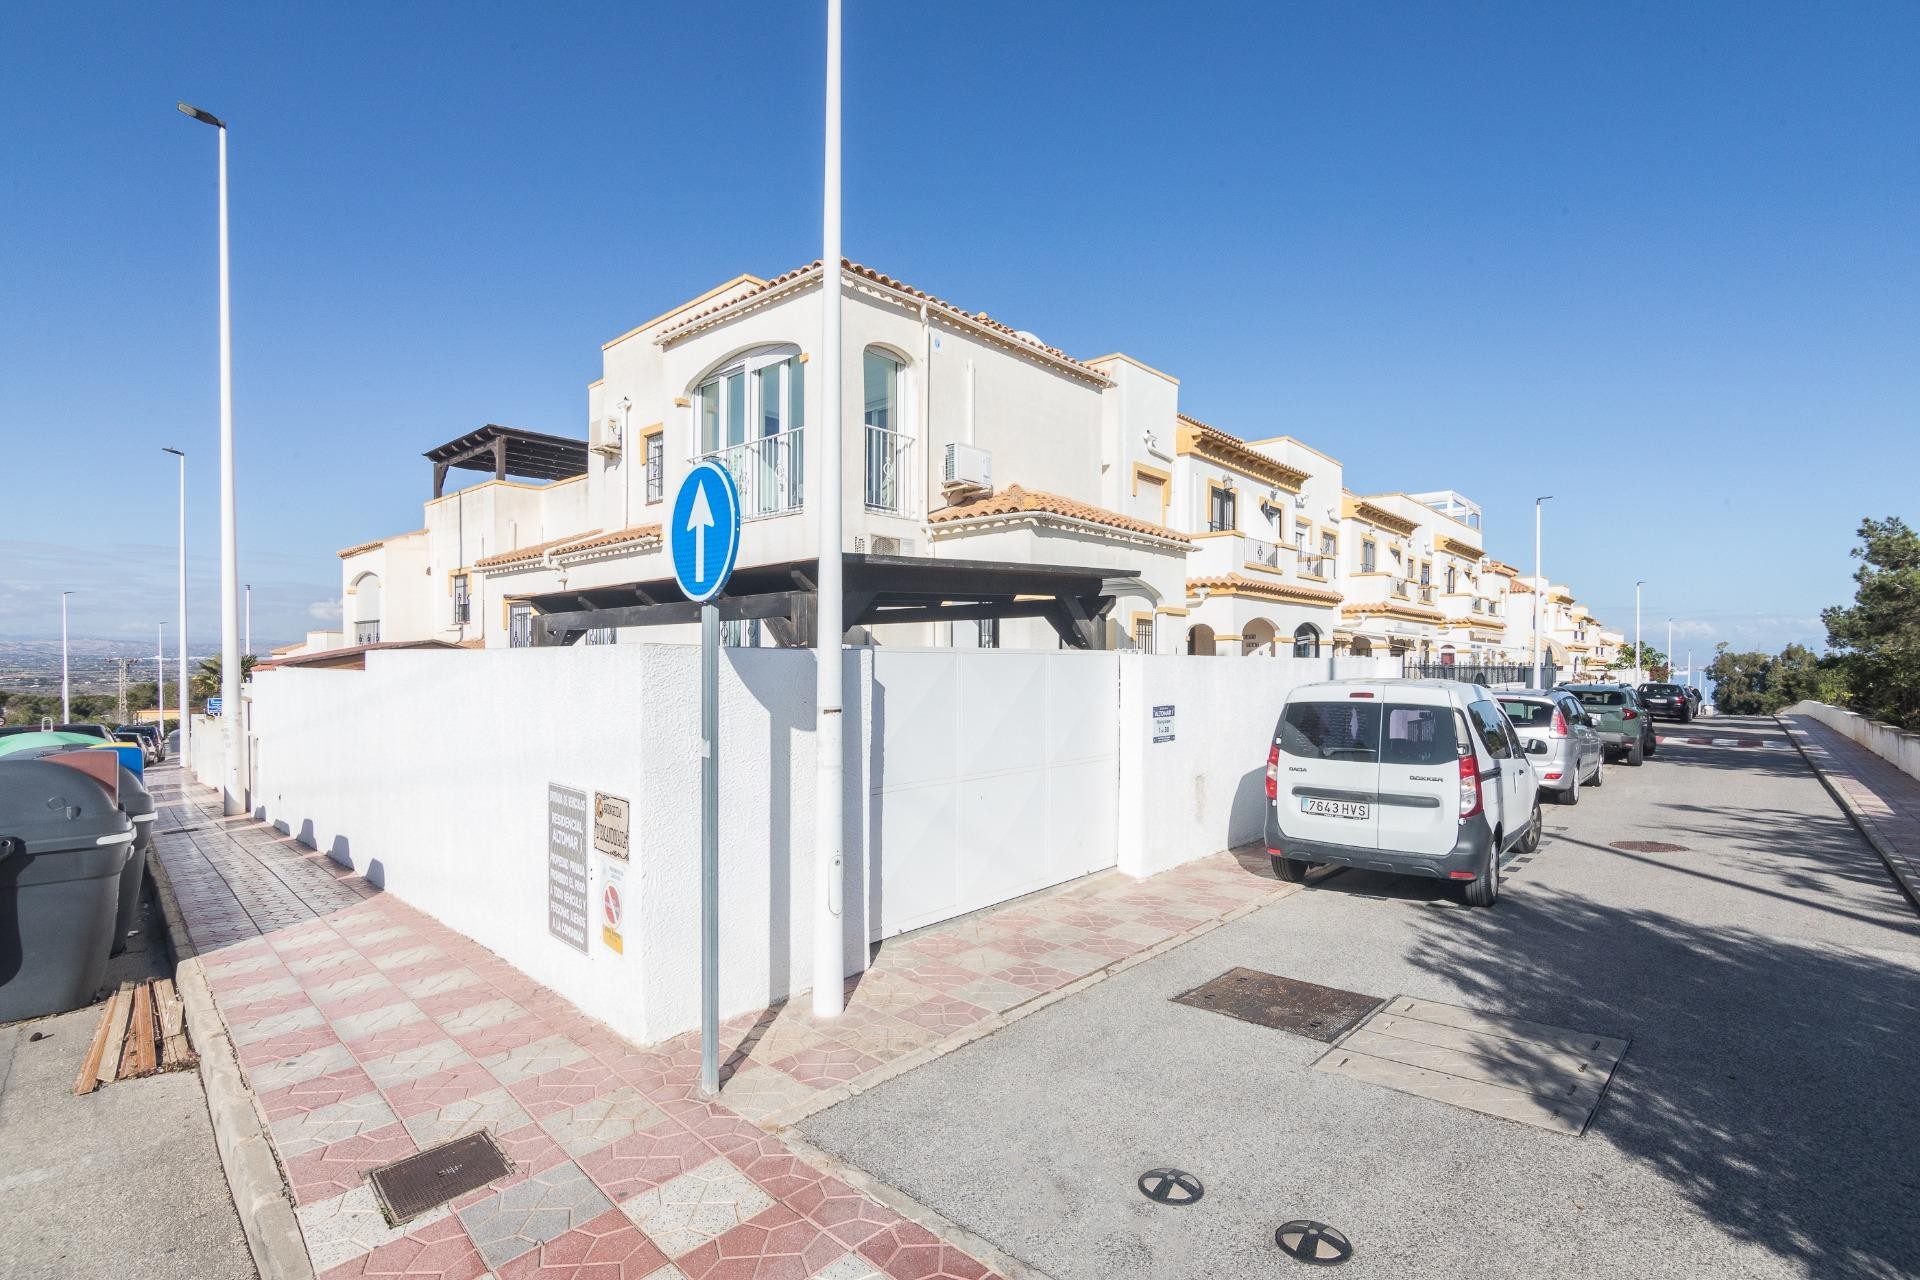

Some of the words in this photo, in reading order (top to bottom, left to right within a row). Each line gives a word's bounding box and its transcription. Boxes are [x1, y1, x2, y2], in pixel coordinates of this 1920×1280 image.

[1309, 800, 1339, 814] 7643
[1342, 803, 1366, 816] HVS
[551, 812, 583, 834] RESIDENCIAL
[552, 829, 578, 850] ALTOMAR
[549, 868, 569, 886] PROHIBIDO
[568, 876, 575, 889] EL
[574, 879, 586, 894] PASO
[553, 885, 564, 900] TODO
[550, 901, 570, 920] PERSONAS
[561, 922, 584, 944] COMUNIDAD
